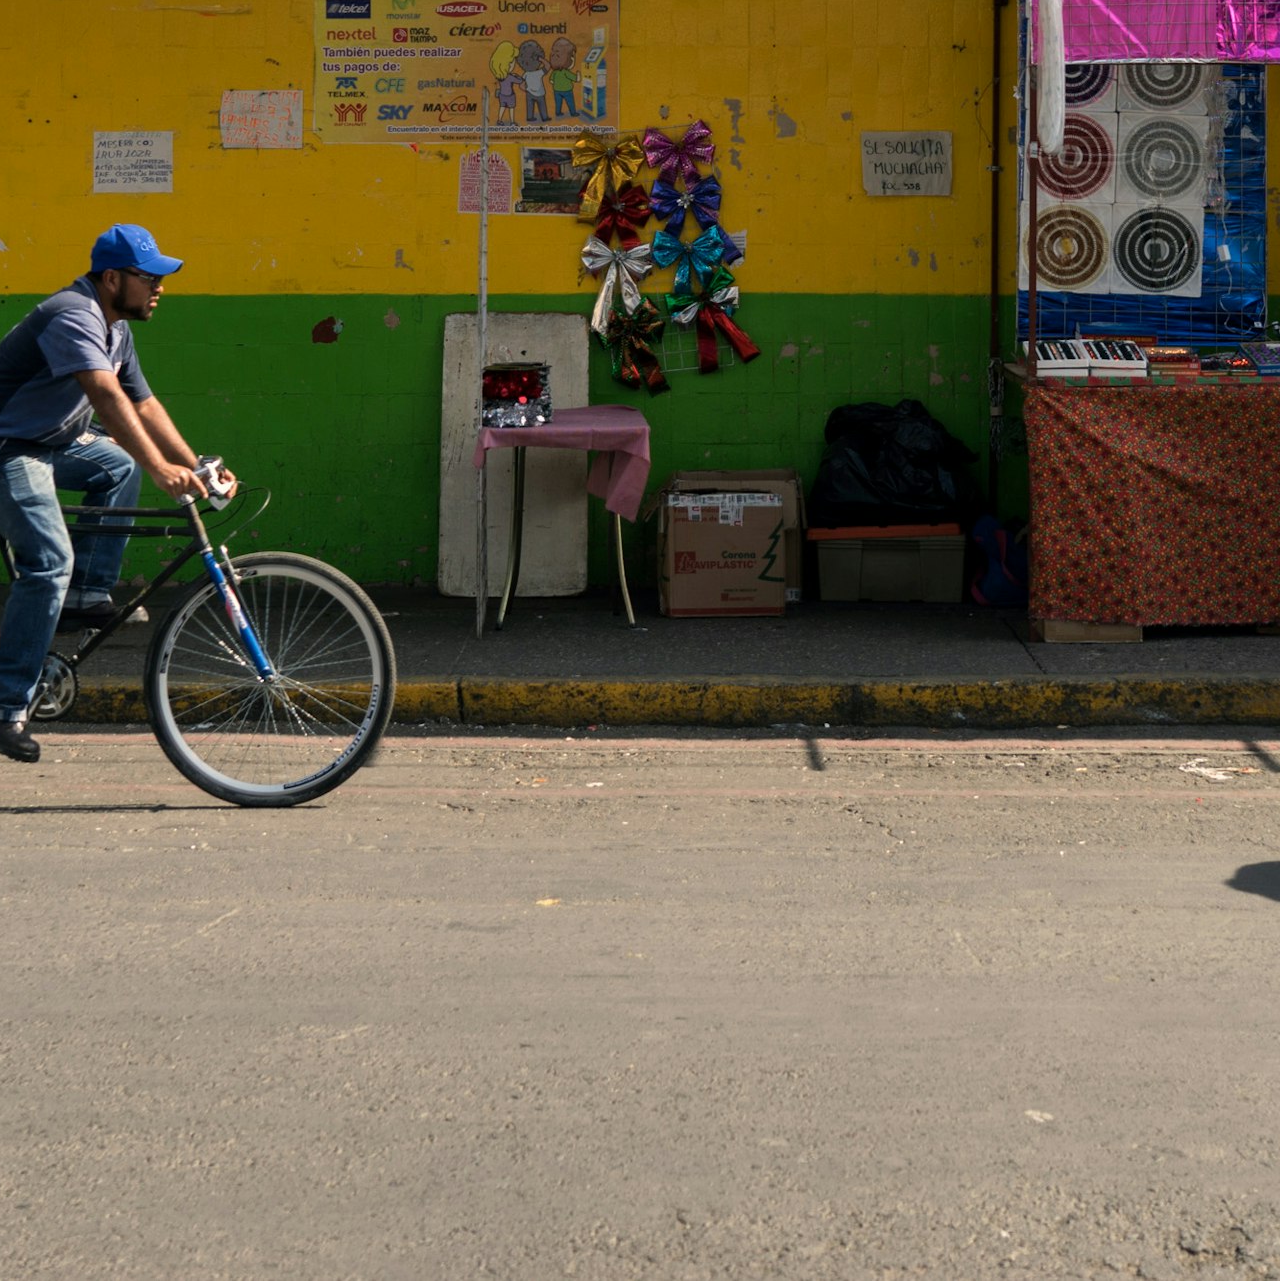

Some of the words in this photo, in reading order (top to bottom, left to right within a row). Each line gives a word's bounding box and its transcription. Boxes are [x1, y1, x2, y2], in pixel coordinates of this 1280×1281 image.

[338, 1, 369, 13] telcel
[498, 0, 545, 12] Unefon
[326, 27, 376, 40] nextel
[449, 23, 494, 37] cierto
[530, 23, 567, 34] tuenti
[323, 47, 370, 57] También
[374, 47, 416, 58] puedes
[419, 47, 461, 57] realizar
[323, 63, 340, 71] tus
[344, 63, 379, 74] pagos
[383, 62, 400, 71] de:
[375, 78, 406, 94] CFE
[417, 78, 475, 90] gasNatural
[377, 105, 415, 120] SKY
[423, 102, 477, 113] MAXCOM
[721, 551, 756, 559] Corona
